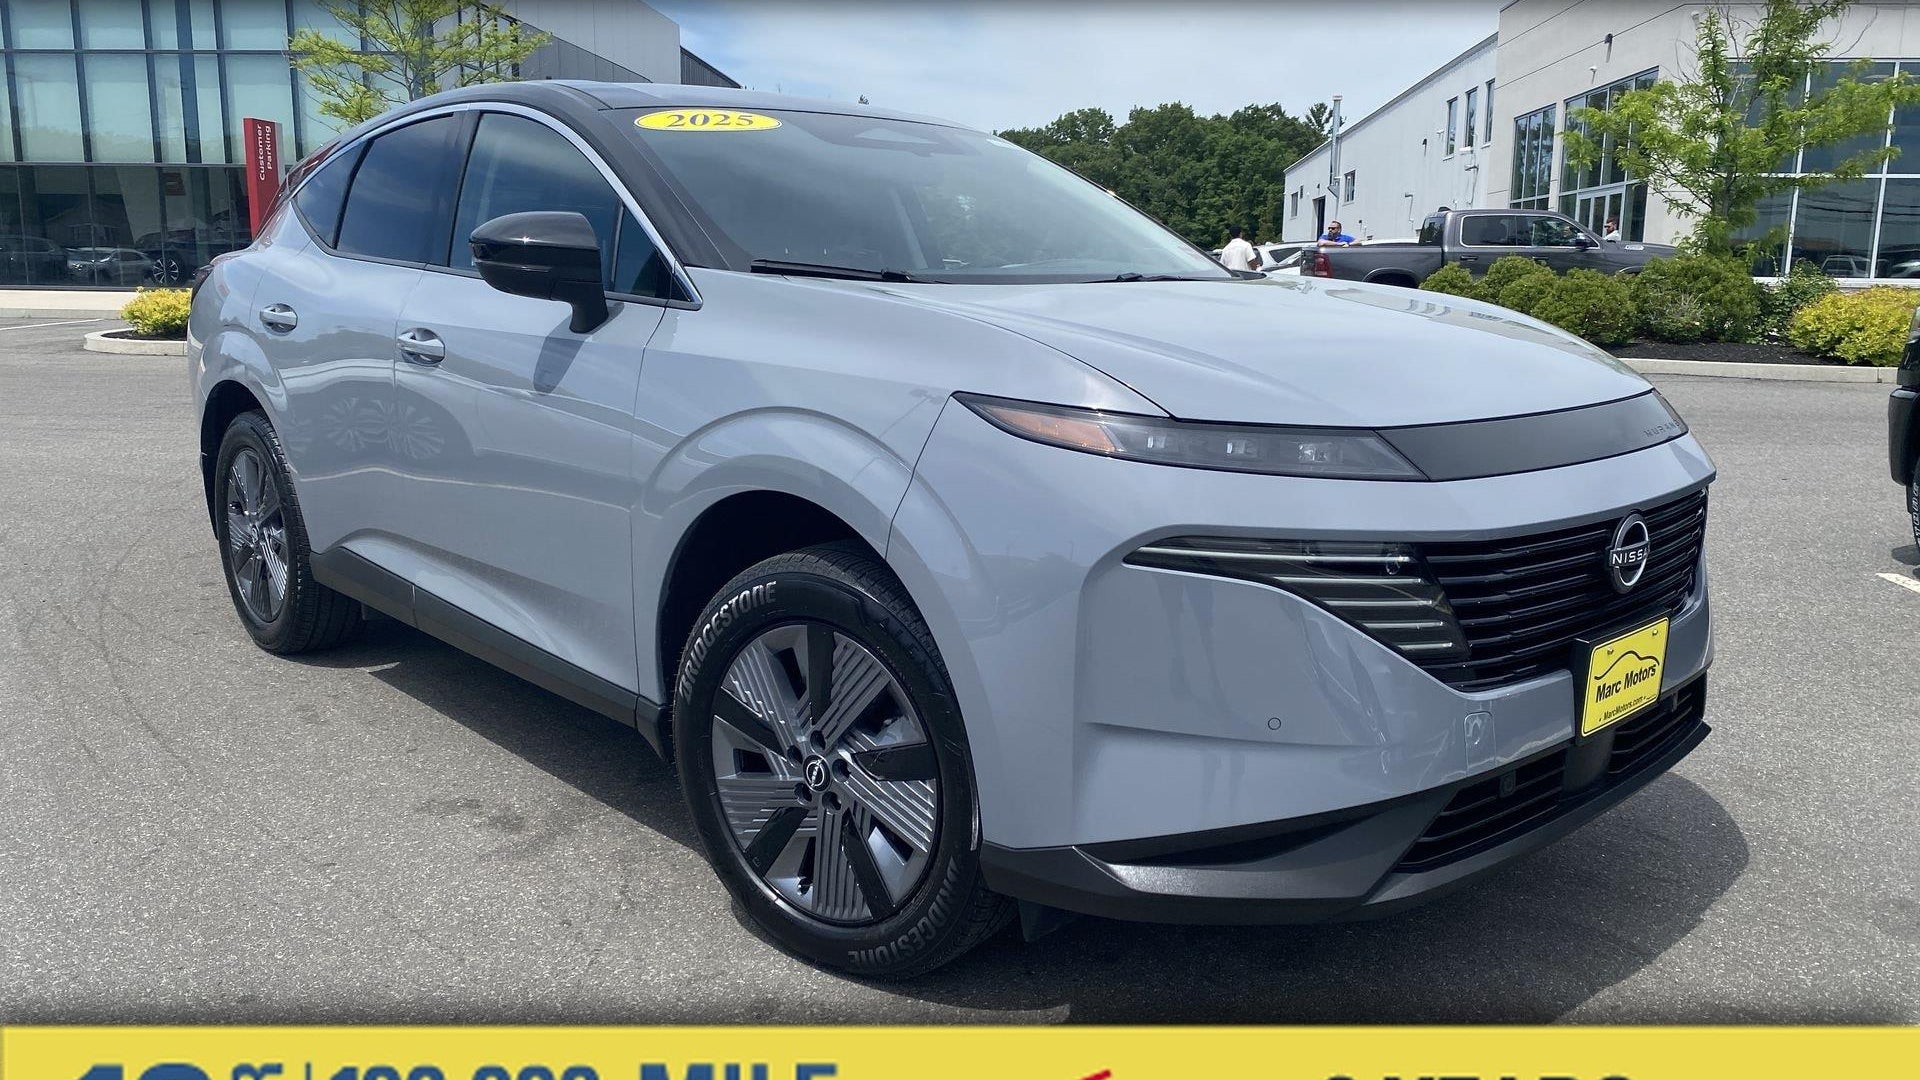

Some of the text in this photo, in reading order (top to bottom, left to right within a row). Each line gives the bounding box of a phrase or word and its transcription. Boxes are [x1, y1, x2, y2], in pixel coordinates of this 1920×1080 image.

[666, 113, 754, 127] 2025
[257, 124, 266, 181] Customer
[265, 125, 273, 170] Parking
[679, 580, 777, 705] BRIDGESTONE
[1596, 664, 1657, 703] Marc Motors
[1603, 696, 1643, 720] MarcMotors.com
